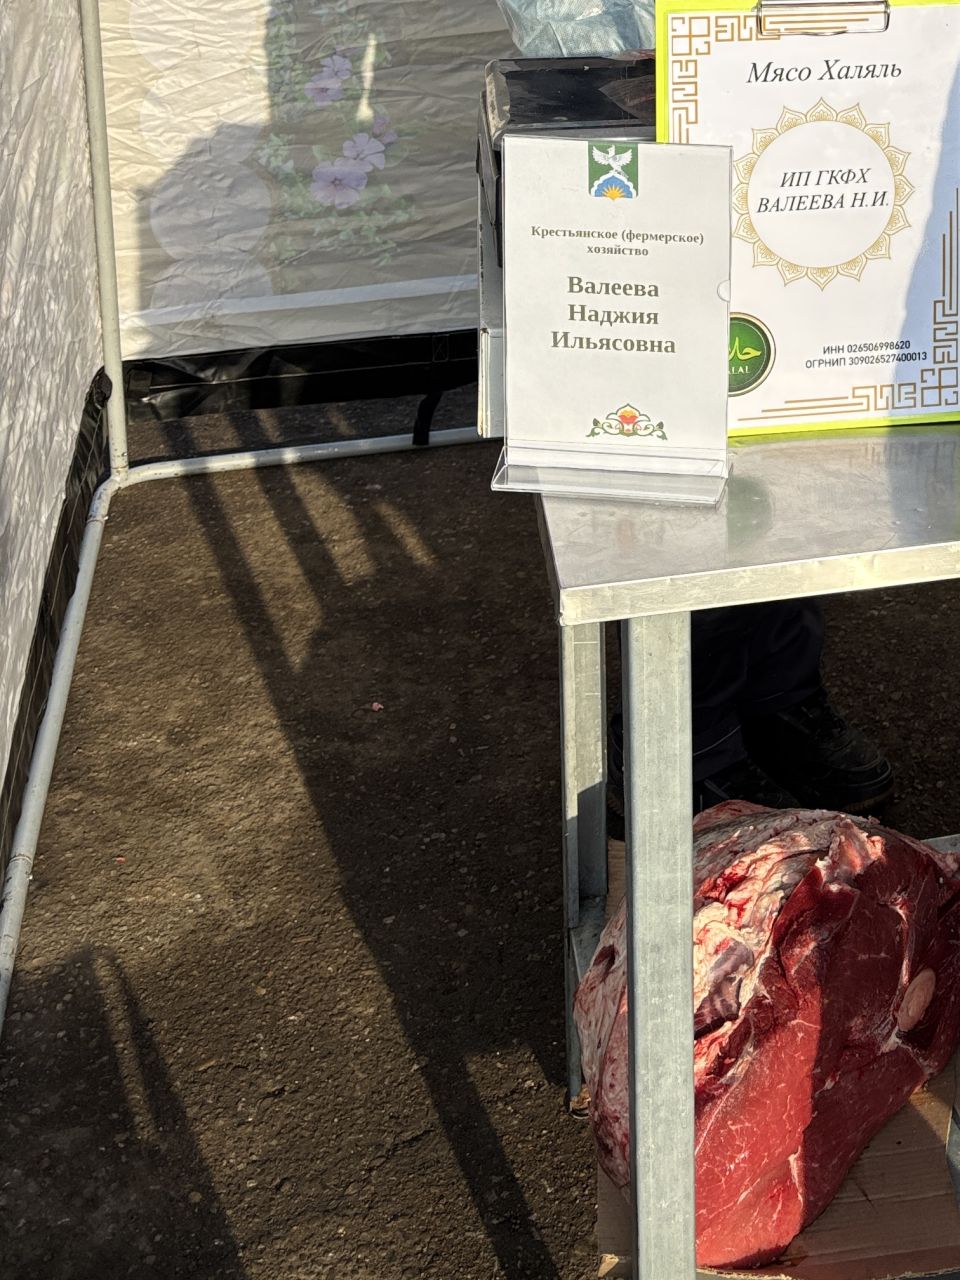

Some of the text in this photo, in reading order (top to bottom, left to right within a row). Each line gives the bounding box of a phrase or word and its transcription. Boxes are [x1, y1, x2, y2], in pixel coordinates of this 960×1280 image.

[745, 59, 903, 84] Мясо Халяль
[780, 168, 872, 188] ИП ГКФХ
[756, 193, 846, 214] ВАЛЕЕВА
[531, 225, 704, 245] Крестьянское (фермерское)
[586, 243, 649, 256] хозяйство
[567, 275, 660, 298] Валеева
[568, 303, 659, 327] Наджия
[551, 331, 676, 354] Ильясовна
[823, 340, 911, 355] ИНН 026506998620
[805, 351, 928, 369] ОГРНИП 309026527400013
